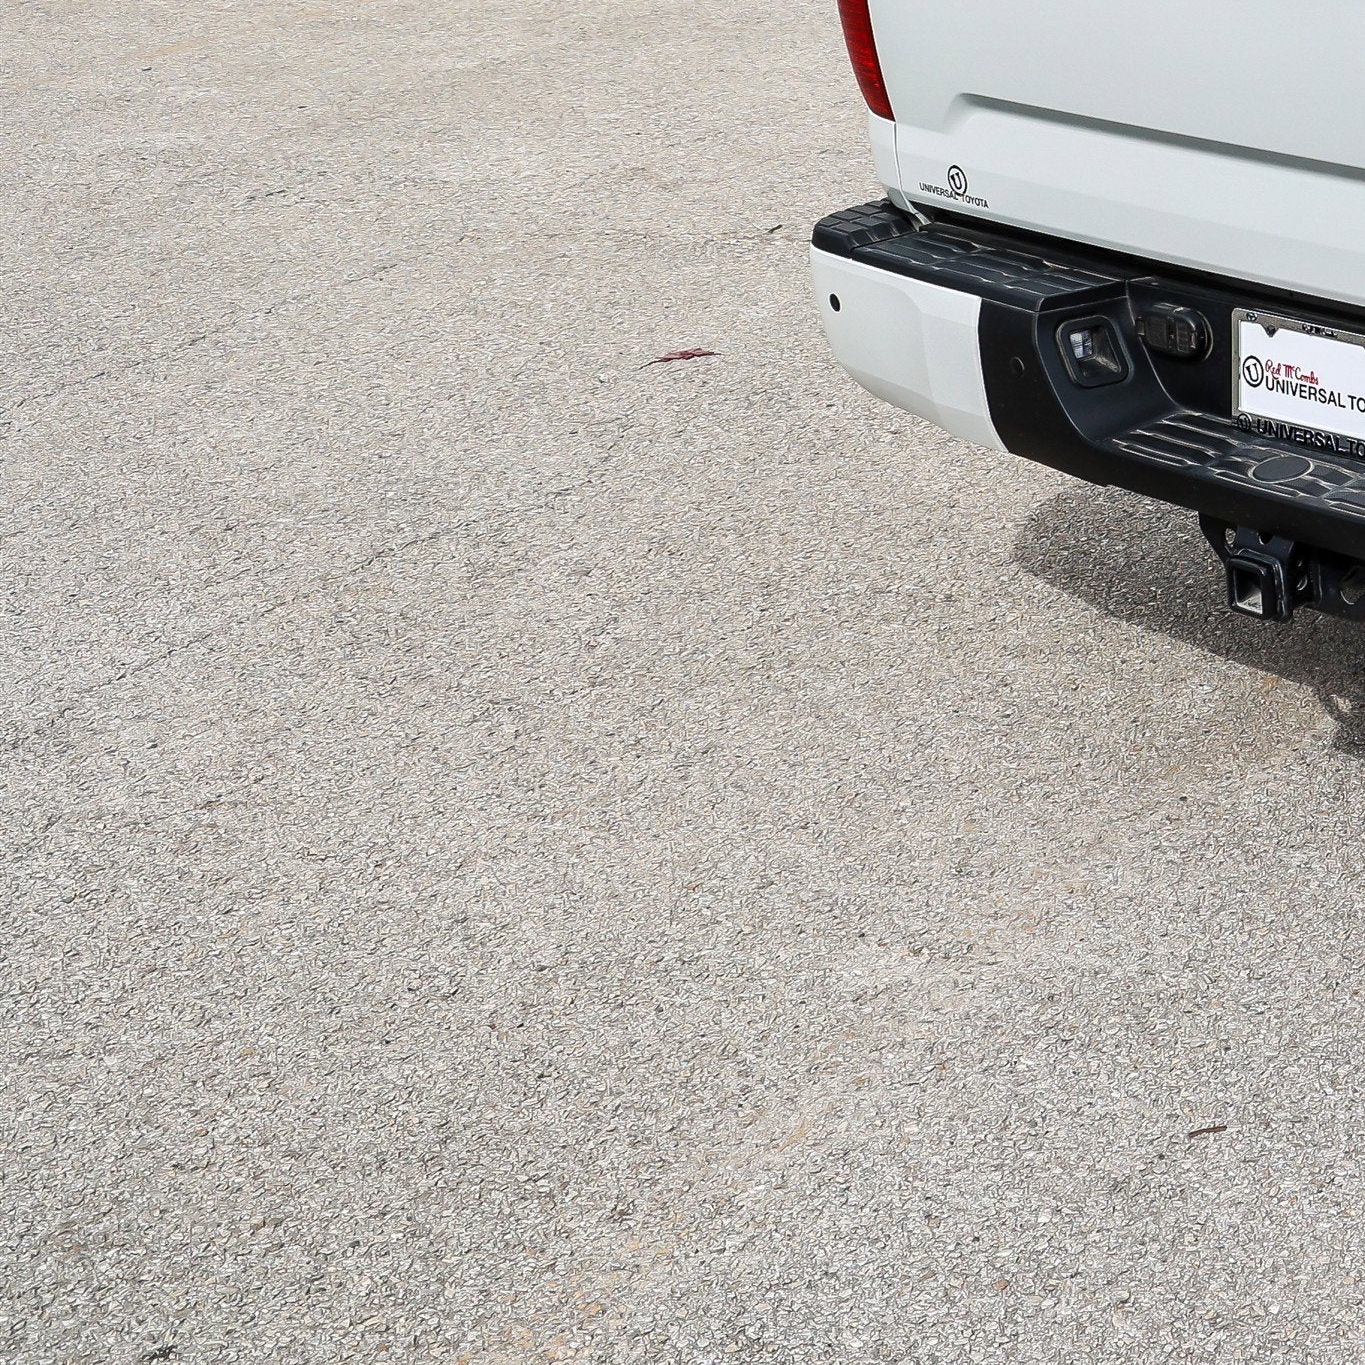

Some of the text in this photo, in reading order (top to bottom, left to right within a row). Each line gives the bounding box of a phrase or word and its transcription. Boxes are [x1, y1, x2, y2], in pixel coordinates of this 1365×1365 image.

[919, 181, 989, 209] UNIVERSAL TOYOTA
[1265, 359, 1319, 385] Red McCombs
[1265, 376, 1346, 409] UNIVERSAL
[1256, 418, 1346, 452] UNIVERSAL
